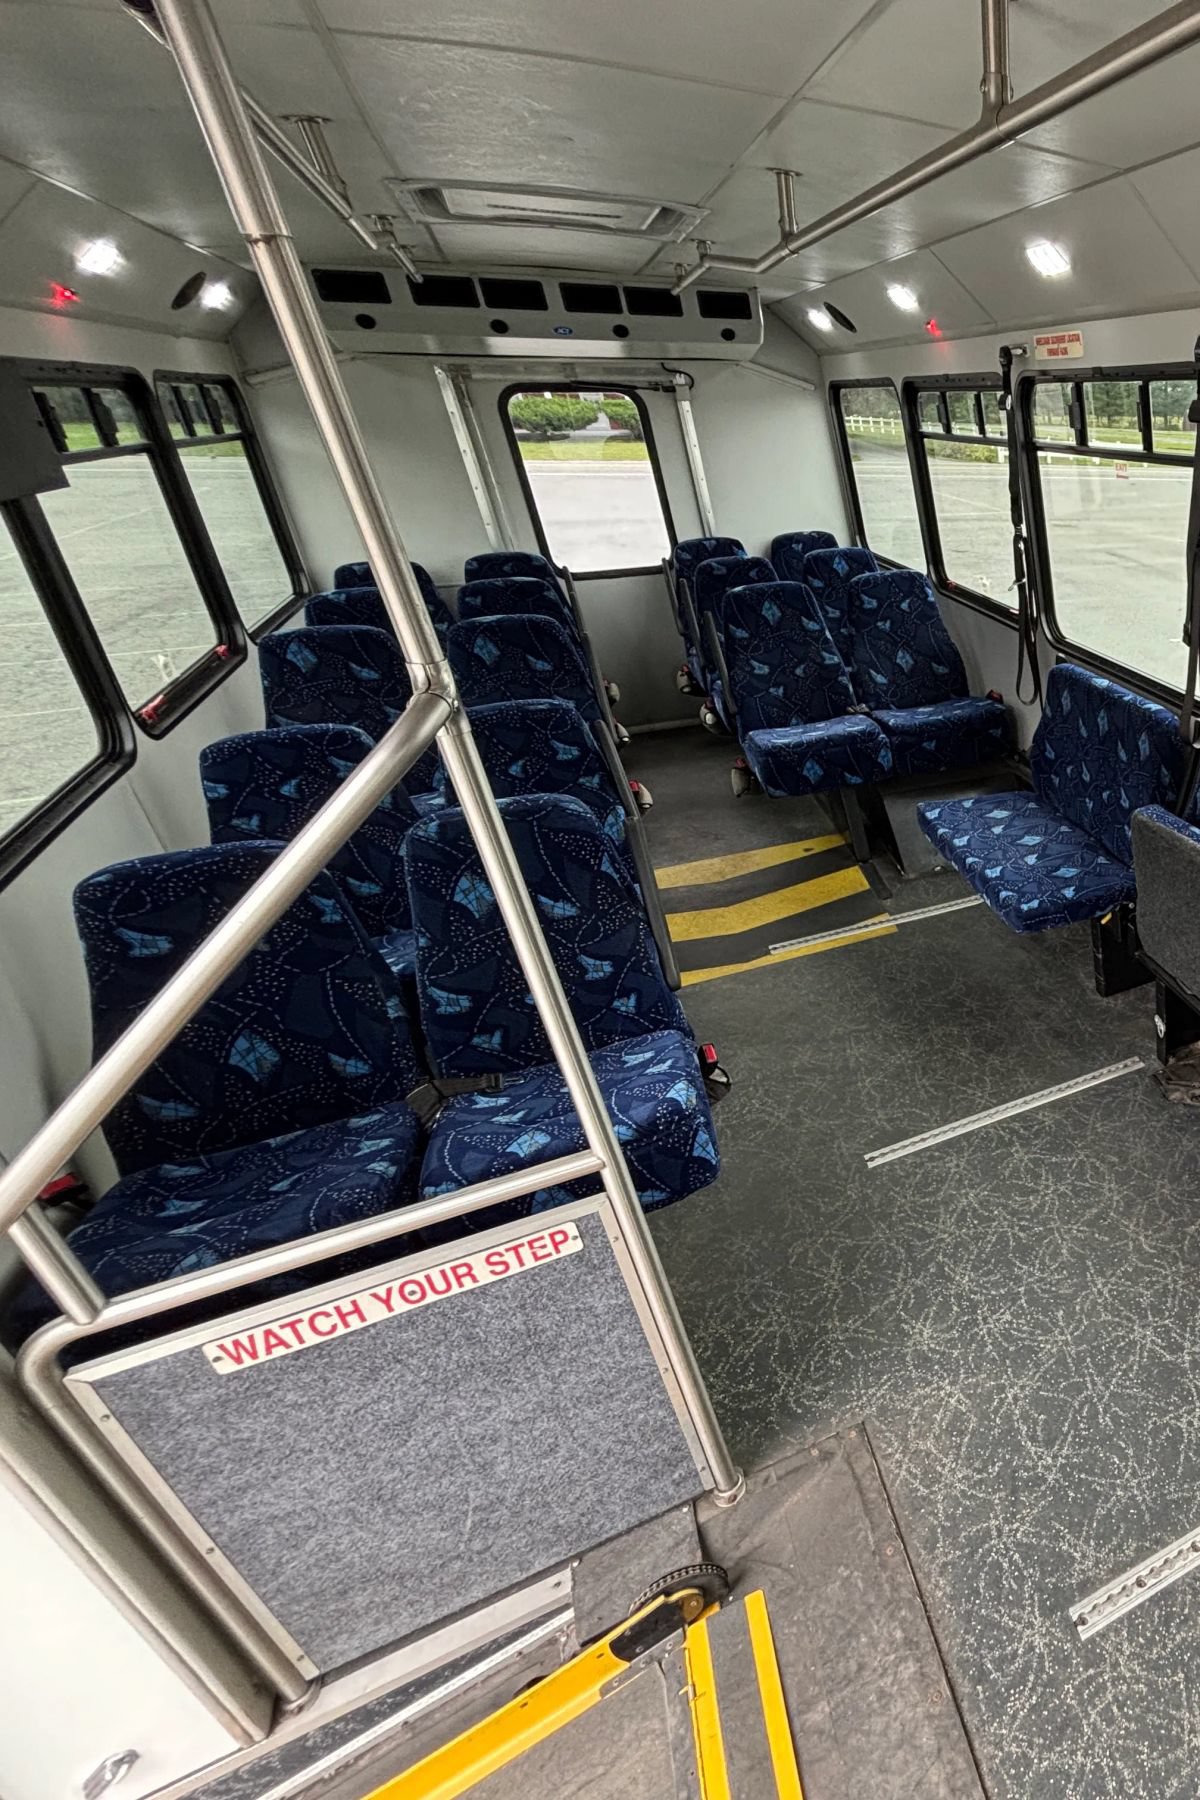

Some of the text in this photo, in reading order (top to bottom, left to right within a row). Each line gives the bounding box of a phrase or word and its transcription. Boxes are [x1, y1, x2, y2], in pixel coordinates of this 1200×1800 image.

[216, 1229, 570, 1366] WATCH YOUR STEP
